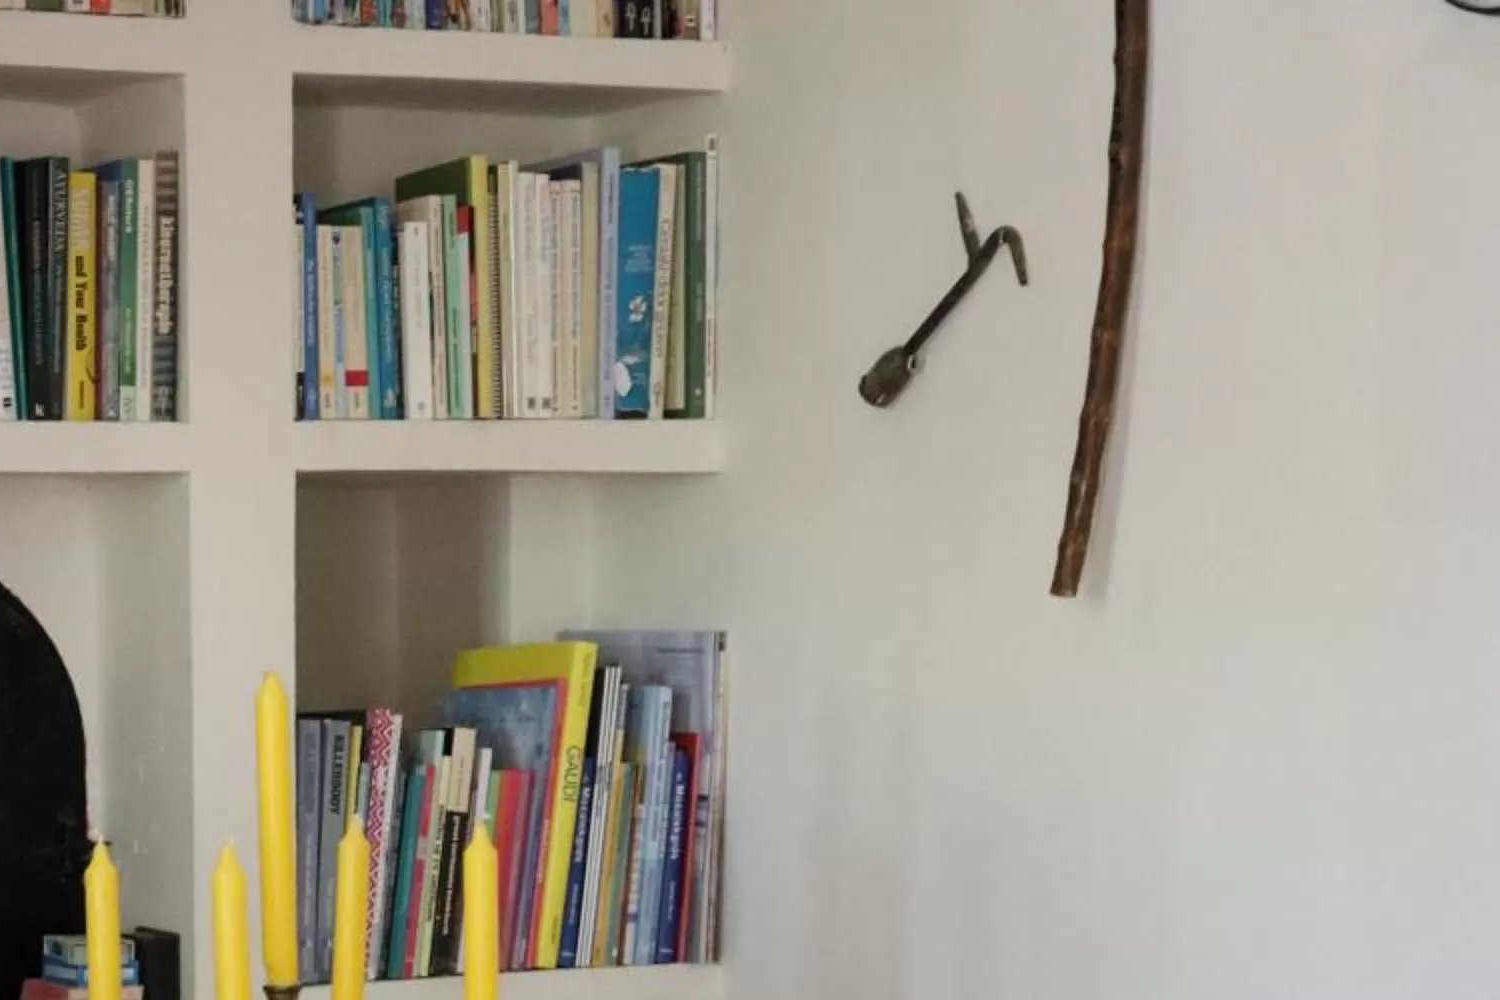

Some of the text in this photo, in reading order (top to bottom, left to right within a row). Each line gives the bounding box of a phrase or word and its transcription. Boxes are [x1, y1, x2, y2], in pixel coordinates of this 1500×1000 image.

[76, 256, 87, 277] and
[77, 283, 88, 309] Your
[77, 315, 88, 351] Health
